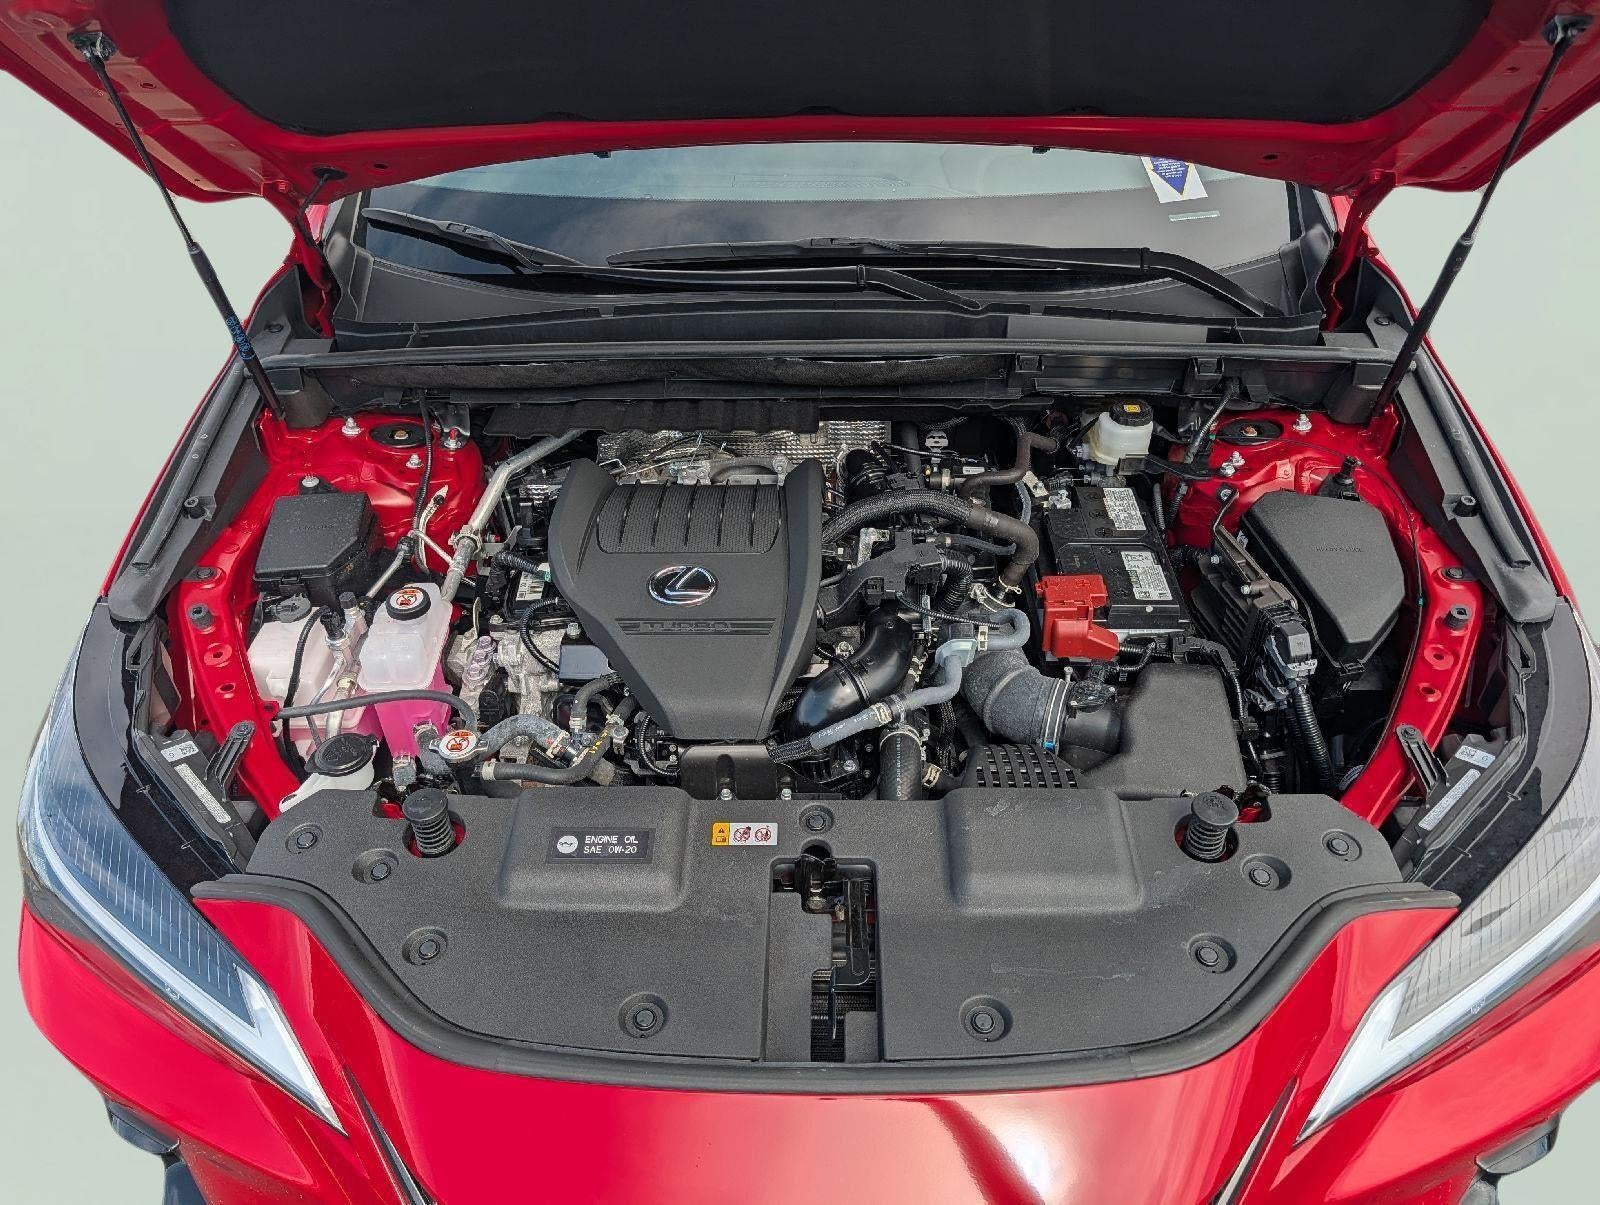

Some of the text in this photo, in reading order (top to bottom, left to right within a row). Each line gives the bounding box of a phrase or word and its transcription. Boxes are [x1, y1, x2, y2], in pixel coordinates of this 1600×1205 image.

[641, 621, 731, 633] TURBO
[585, 835, 639, 844] ENGINE OIL
[583, 845, 637, 854] SAE 0W-20
